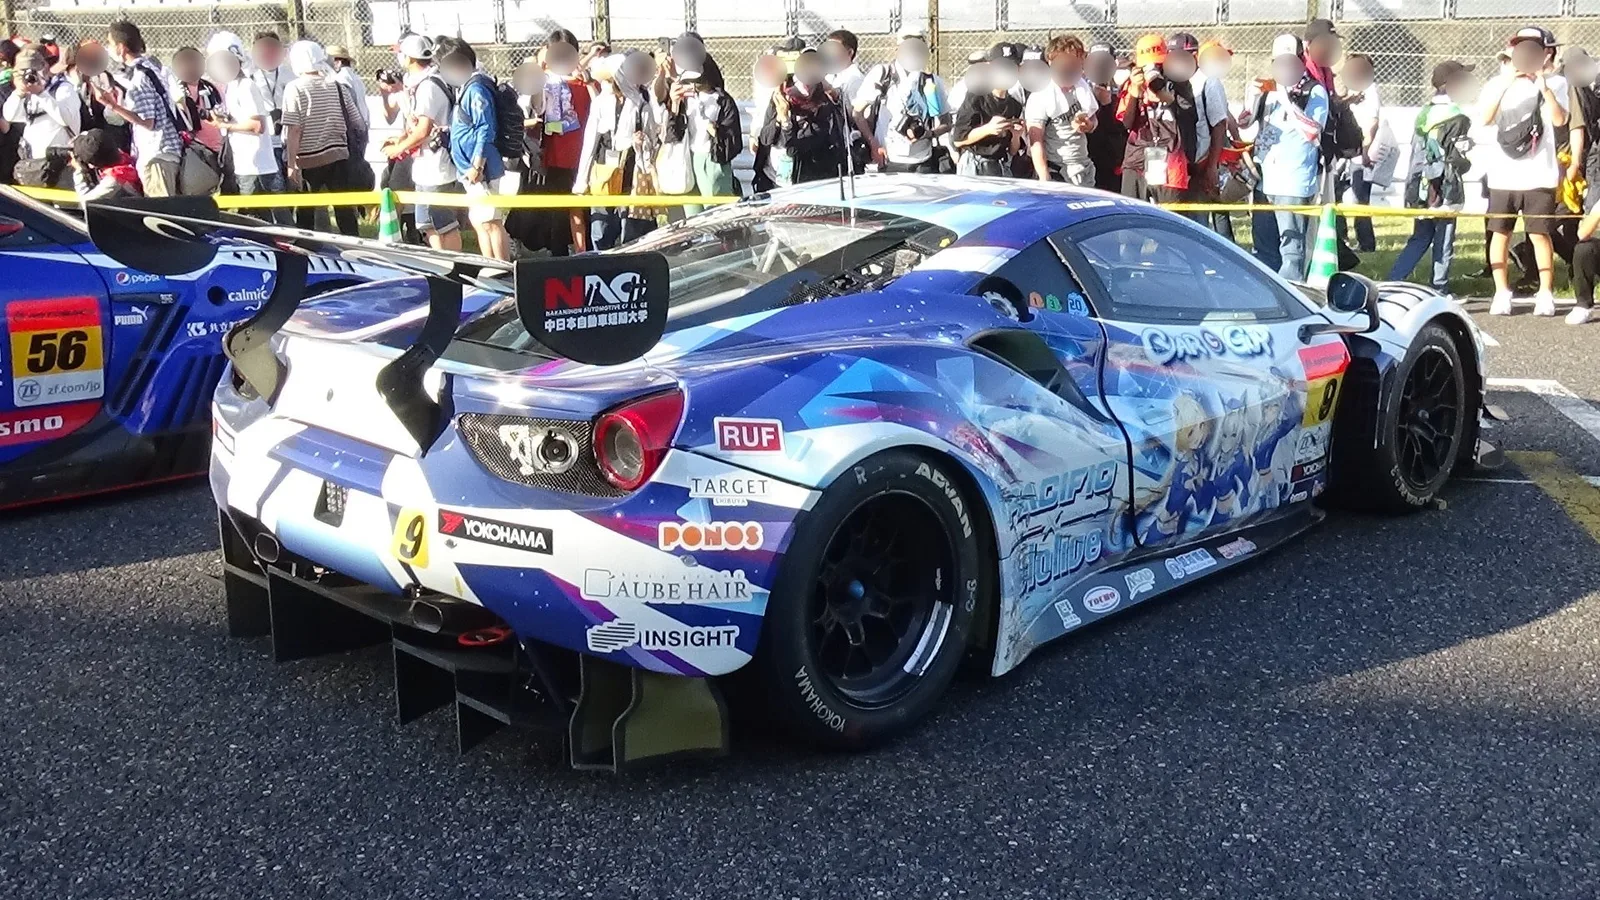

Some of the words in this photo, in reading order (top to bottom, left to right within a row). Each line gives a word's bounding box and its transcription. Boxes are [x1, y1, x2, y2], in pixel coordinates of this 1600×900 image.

[583, 303, 621, 313] AUTOMOTIVE
[27, 330, 88, 374] 56
[723, 425, 775, 448] RUF
[691, 477, 769, 495] TARGET
[915, 462, 972, 539] ADVAN
[399, 514, 426, 560] 9
[463, 518, 548, 551] YOKOHAMA
[663, 525, 760, 547] PONOS
[615, 580, 682, 600] AUBE
[688, 580, 749, 600] HAIR
[645, 629, 737, 647] INSIGHT
[794, 665, 847, 733] YOKOHAMA
